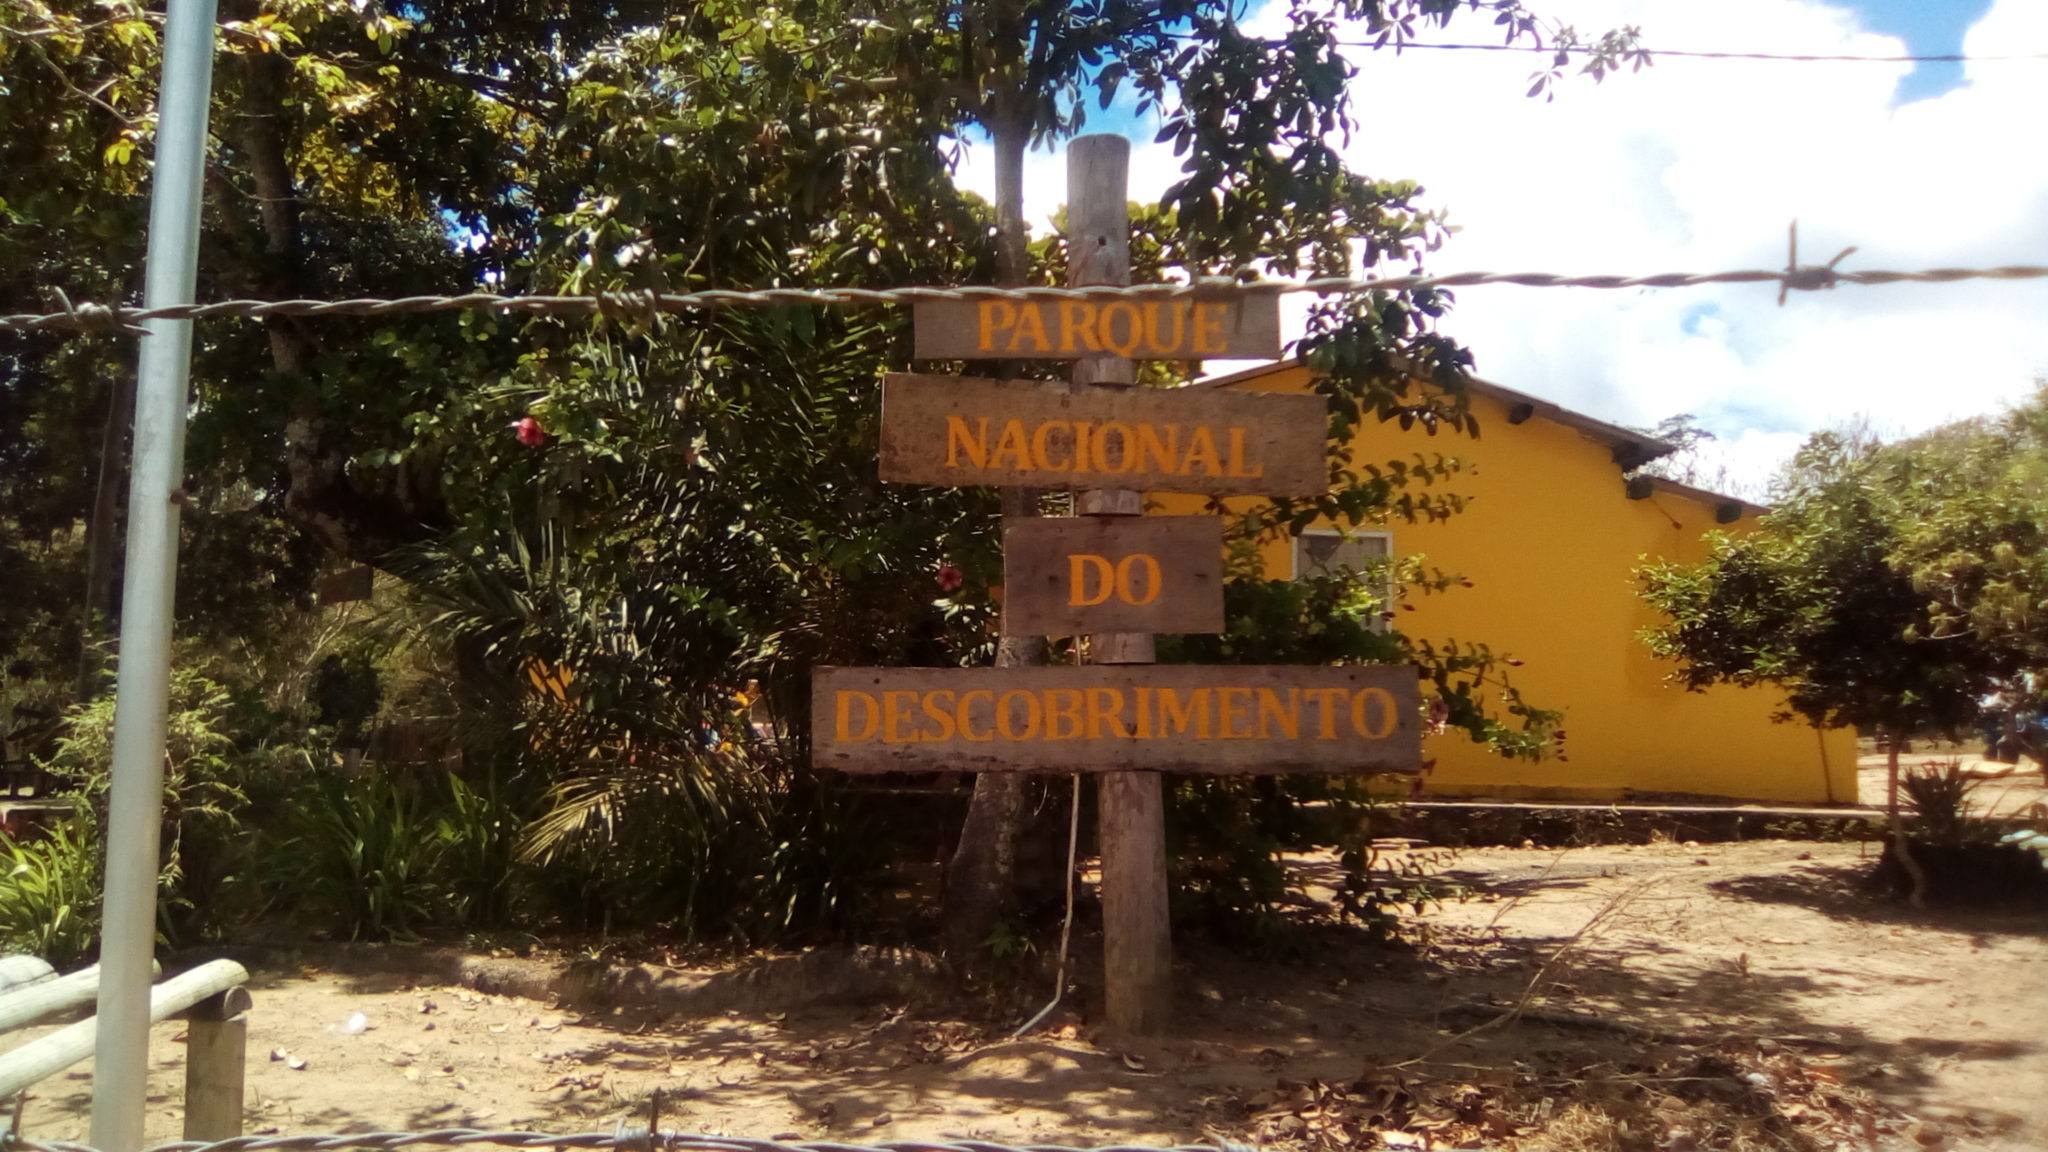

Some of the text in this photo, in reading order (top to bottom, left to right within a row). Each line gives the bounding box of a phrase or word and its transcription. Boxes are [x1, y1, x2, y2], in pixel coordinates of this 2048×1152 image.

[977, 299, 1228, 357] PARQUE
[944, 415, 1265, 479] NACIONAL
[1067, 553, 1163, 607] DO
[834, 686, 1398, 745] DESCOBRIMENTO
